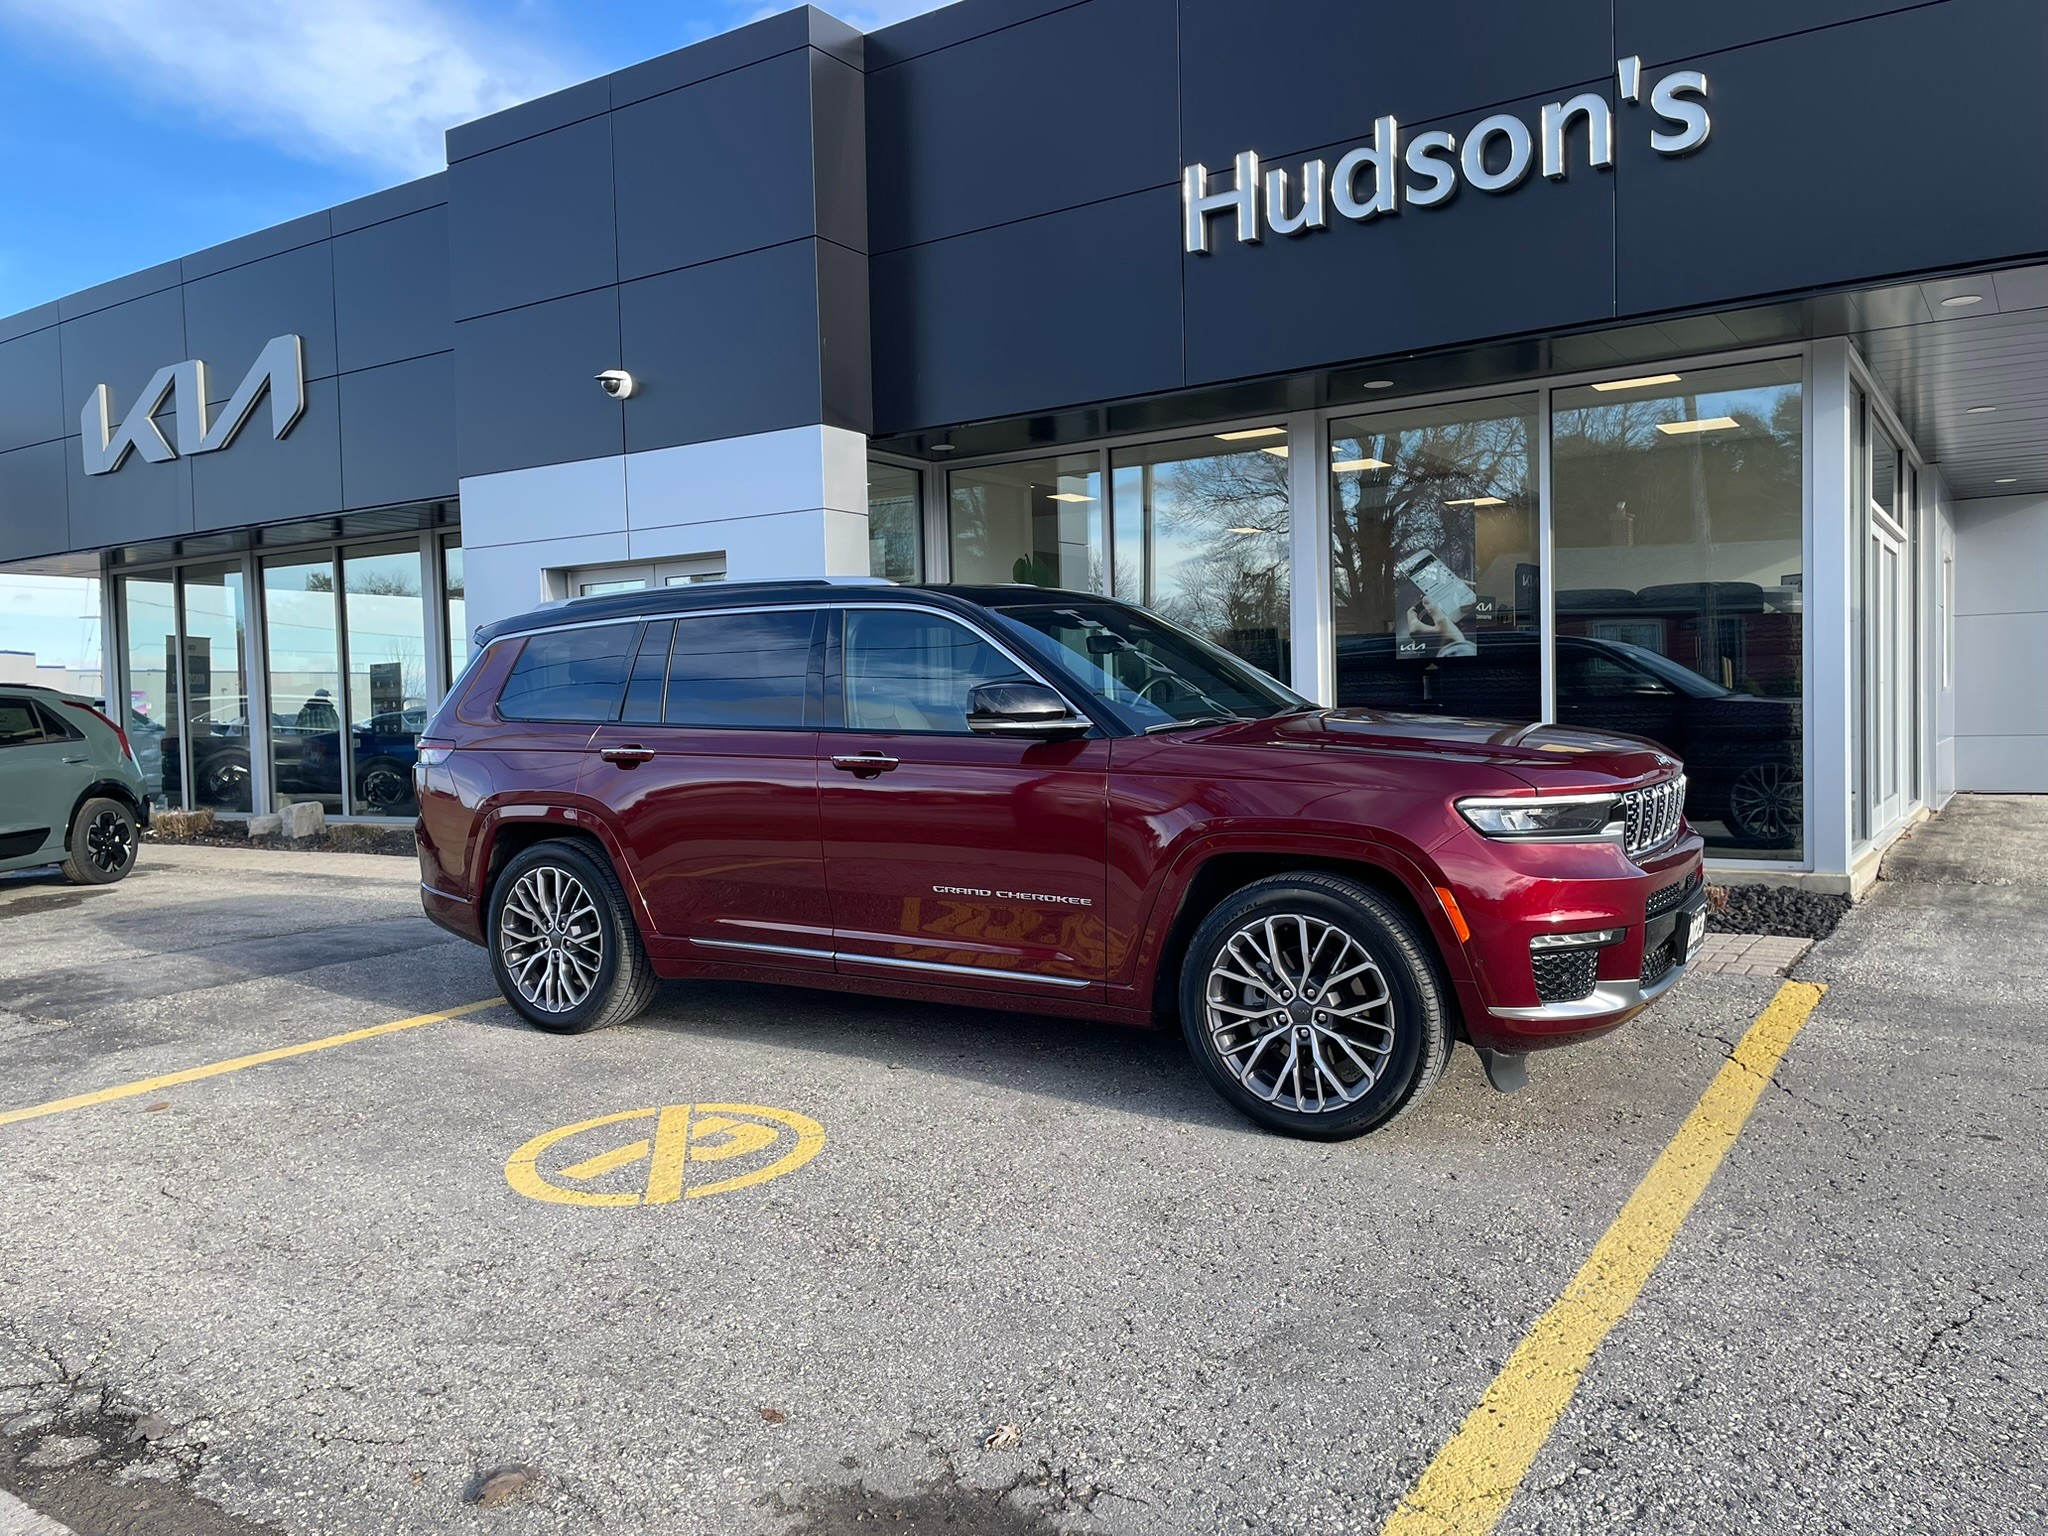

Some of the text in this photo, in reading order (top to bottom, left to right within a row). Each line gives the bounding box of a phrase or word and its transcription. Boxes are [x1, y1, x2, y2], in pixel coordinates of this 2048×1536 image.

[1183, 55, 1711, 254] Hudson's
[81, 334, 304, 475] KIA
[1400, 643, 1425, 651] KIA
[933, 885, 1092, 906] GRAND CHEROKEE
